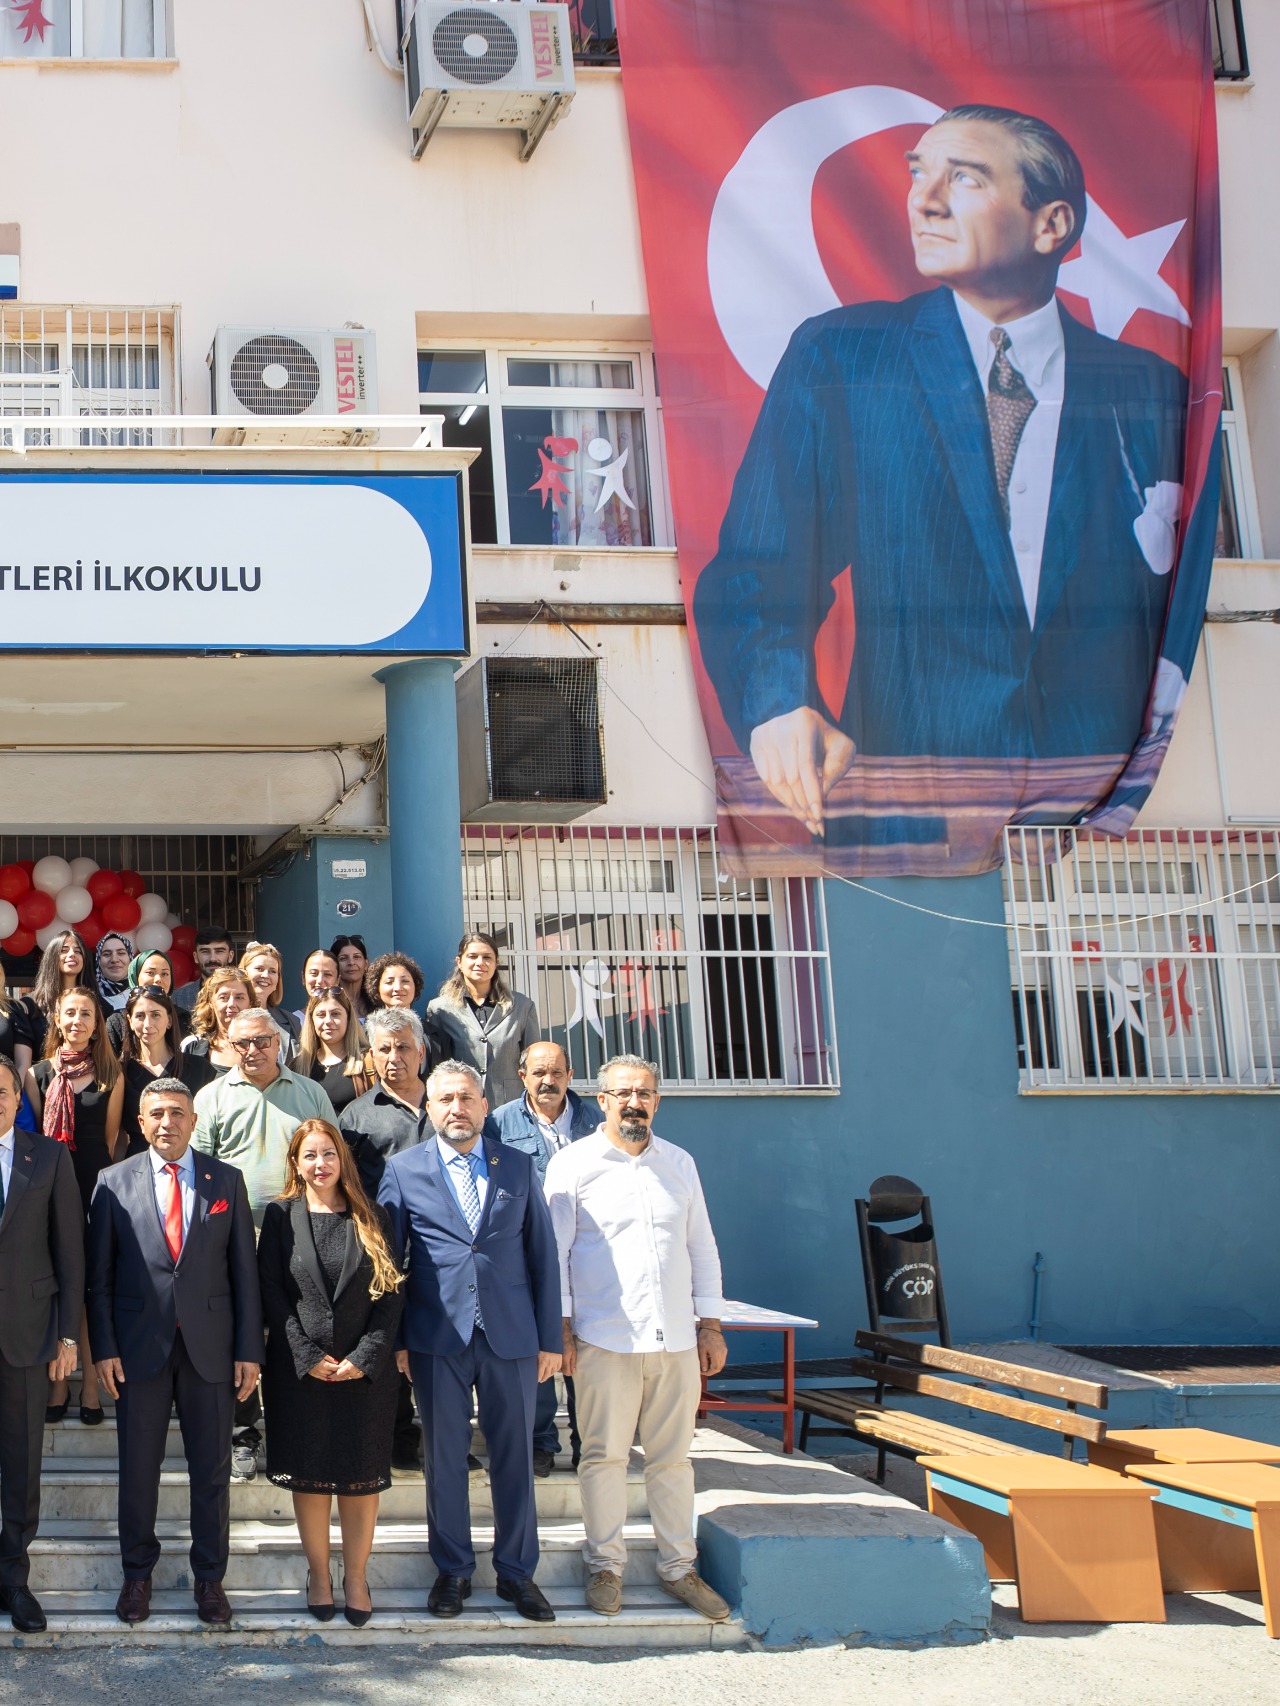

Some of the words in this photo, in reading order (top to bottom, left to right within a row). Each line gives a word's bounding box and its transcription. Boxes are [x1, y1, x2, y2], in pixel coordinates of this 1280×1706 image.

[530, 13, 553, 79] VESTEL
[335, 341, 356, 414] VESTEL
[93, 559, 262, 592] İLKOKULU
[902, 1276, 934, 1299] ÇÖP
